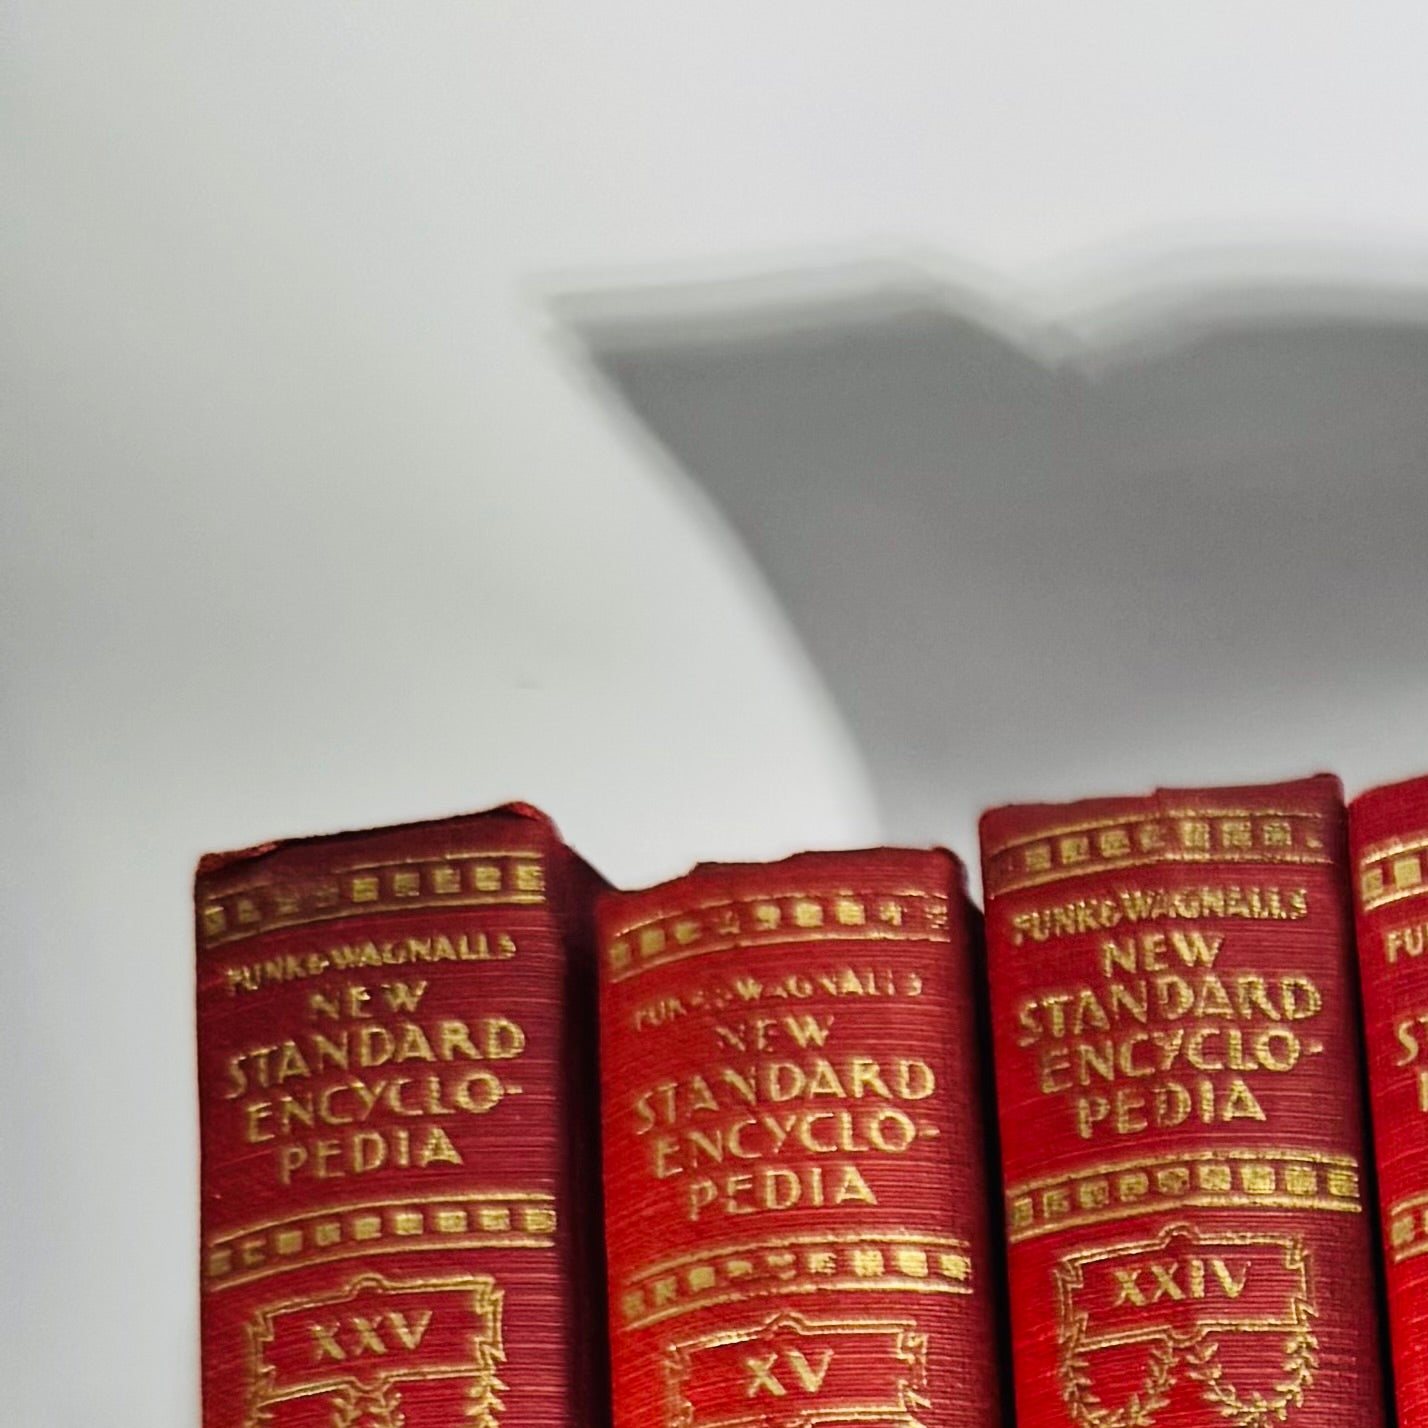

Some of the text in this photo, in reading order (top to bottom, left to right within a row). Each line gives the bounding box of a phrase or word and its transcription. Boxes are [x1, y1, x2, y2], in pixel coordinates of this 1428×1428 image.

[1102, 932, 1224, 977] NEW
[308, 981, 428, 1018] NEW
[1019, 975, 1323, 1046] STANDARD
[225, 1018, 526, 1099] STANDARD
[714, 1015, 835, 1051] NEW
[1040, 1028, 1324, 1093] ENCYCLO-
[246, 1070, 523, 1143] ENCYCLO-
[635, 1058, 936, 1135] STANDARD
[1077, 1080, 1267, 1139] PEDIA
[280, 1126, 463, 1184] PEDIA
[655, 1109, 940, 1179] ENCYCLO-
[689, 1166, 877, 1221] PEDIA
[1113, 1258, 1252, 1307] XXIV
[308, 1309, 433, 1361] XXV
[746, 1349, 835, 1397] XV
